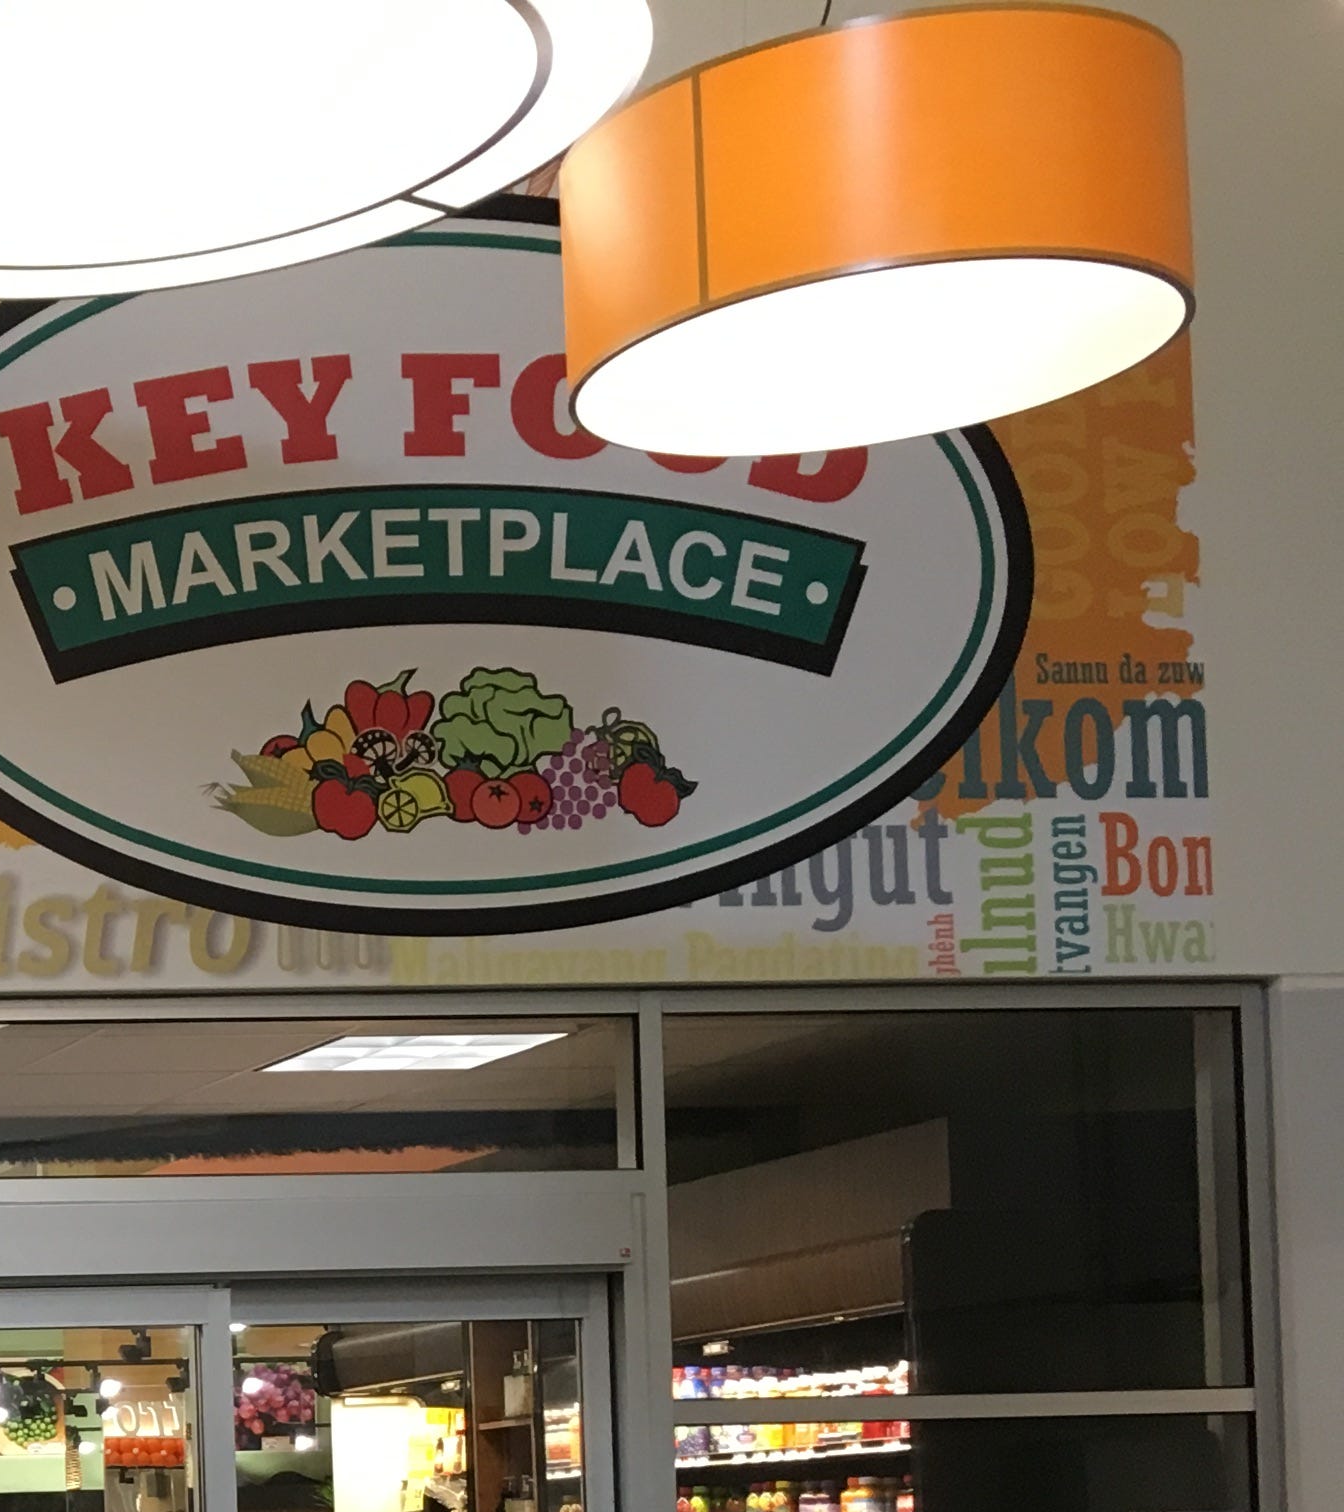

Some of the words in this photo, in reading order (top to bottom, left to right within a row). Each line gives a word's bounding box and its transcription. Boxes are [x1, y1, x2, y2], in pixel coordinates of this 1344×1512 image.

[401, 352, 869, 503] FO
[88, 505, 791, 622] MARKETPLACE
[1036, 653, 1109, 685] Sannu
[1118, 653, 1148, 685] da
[1102, 903, 1216, 964] Hwa
